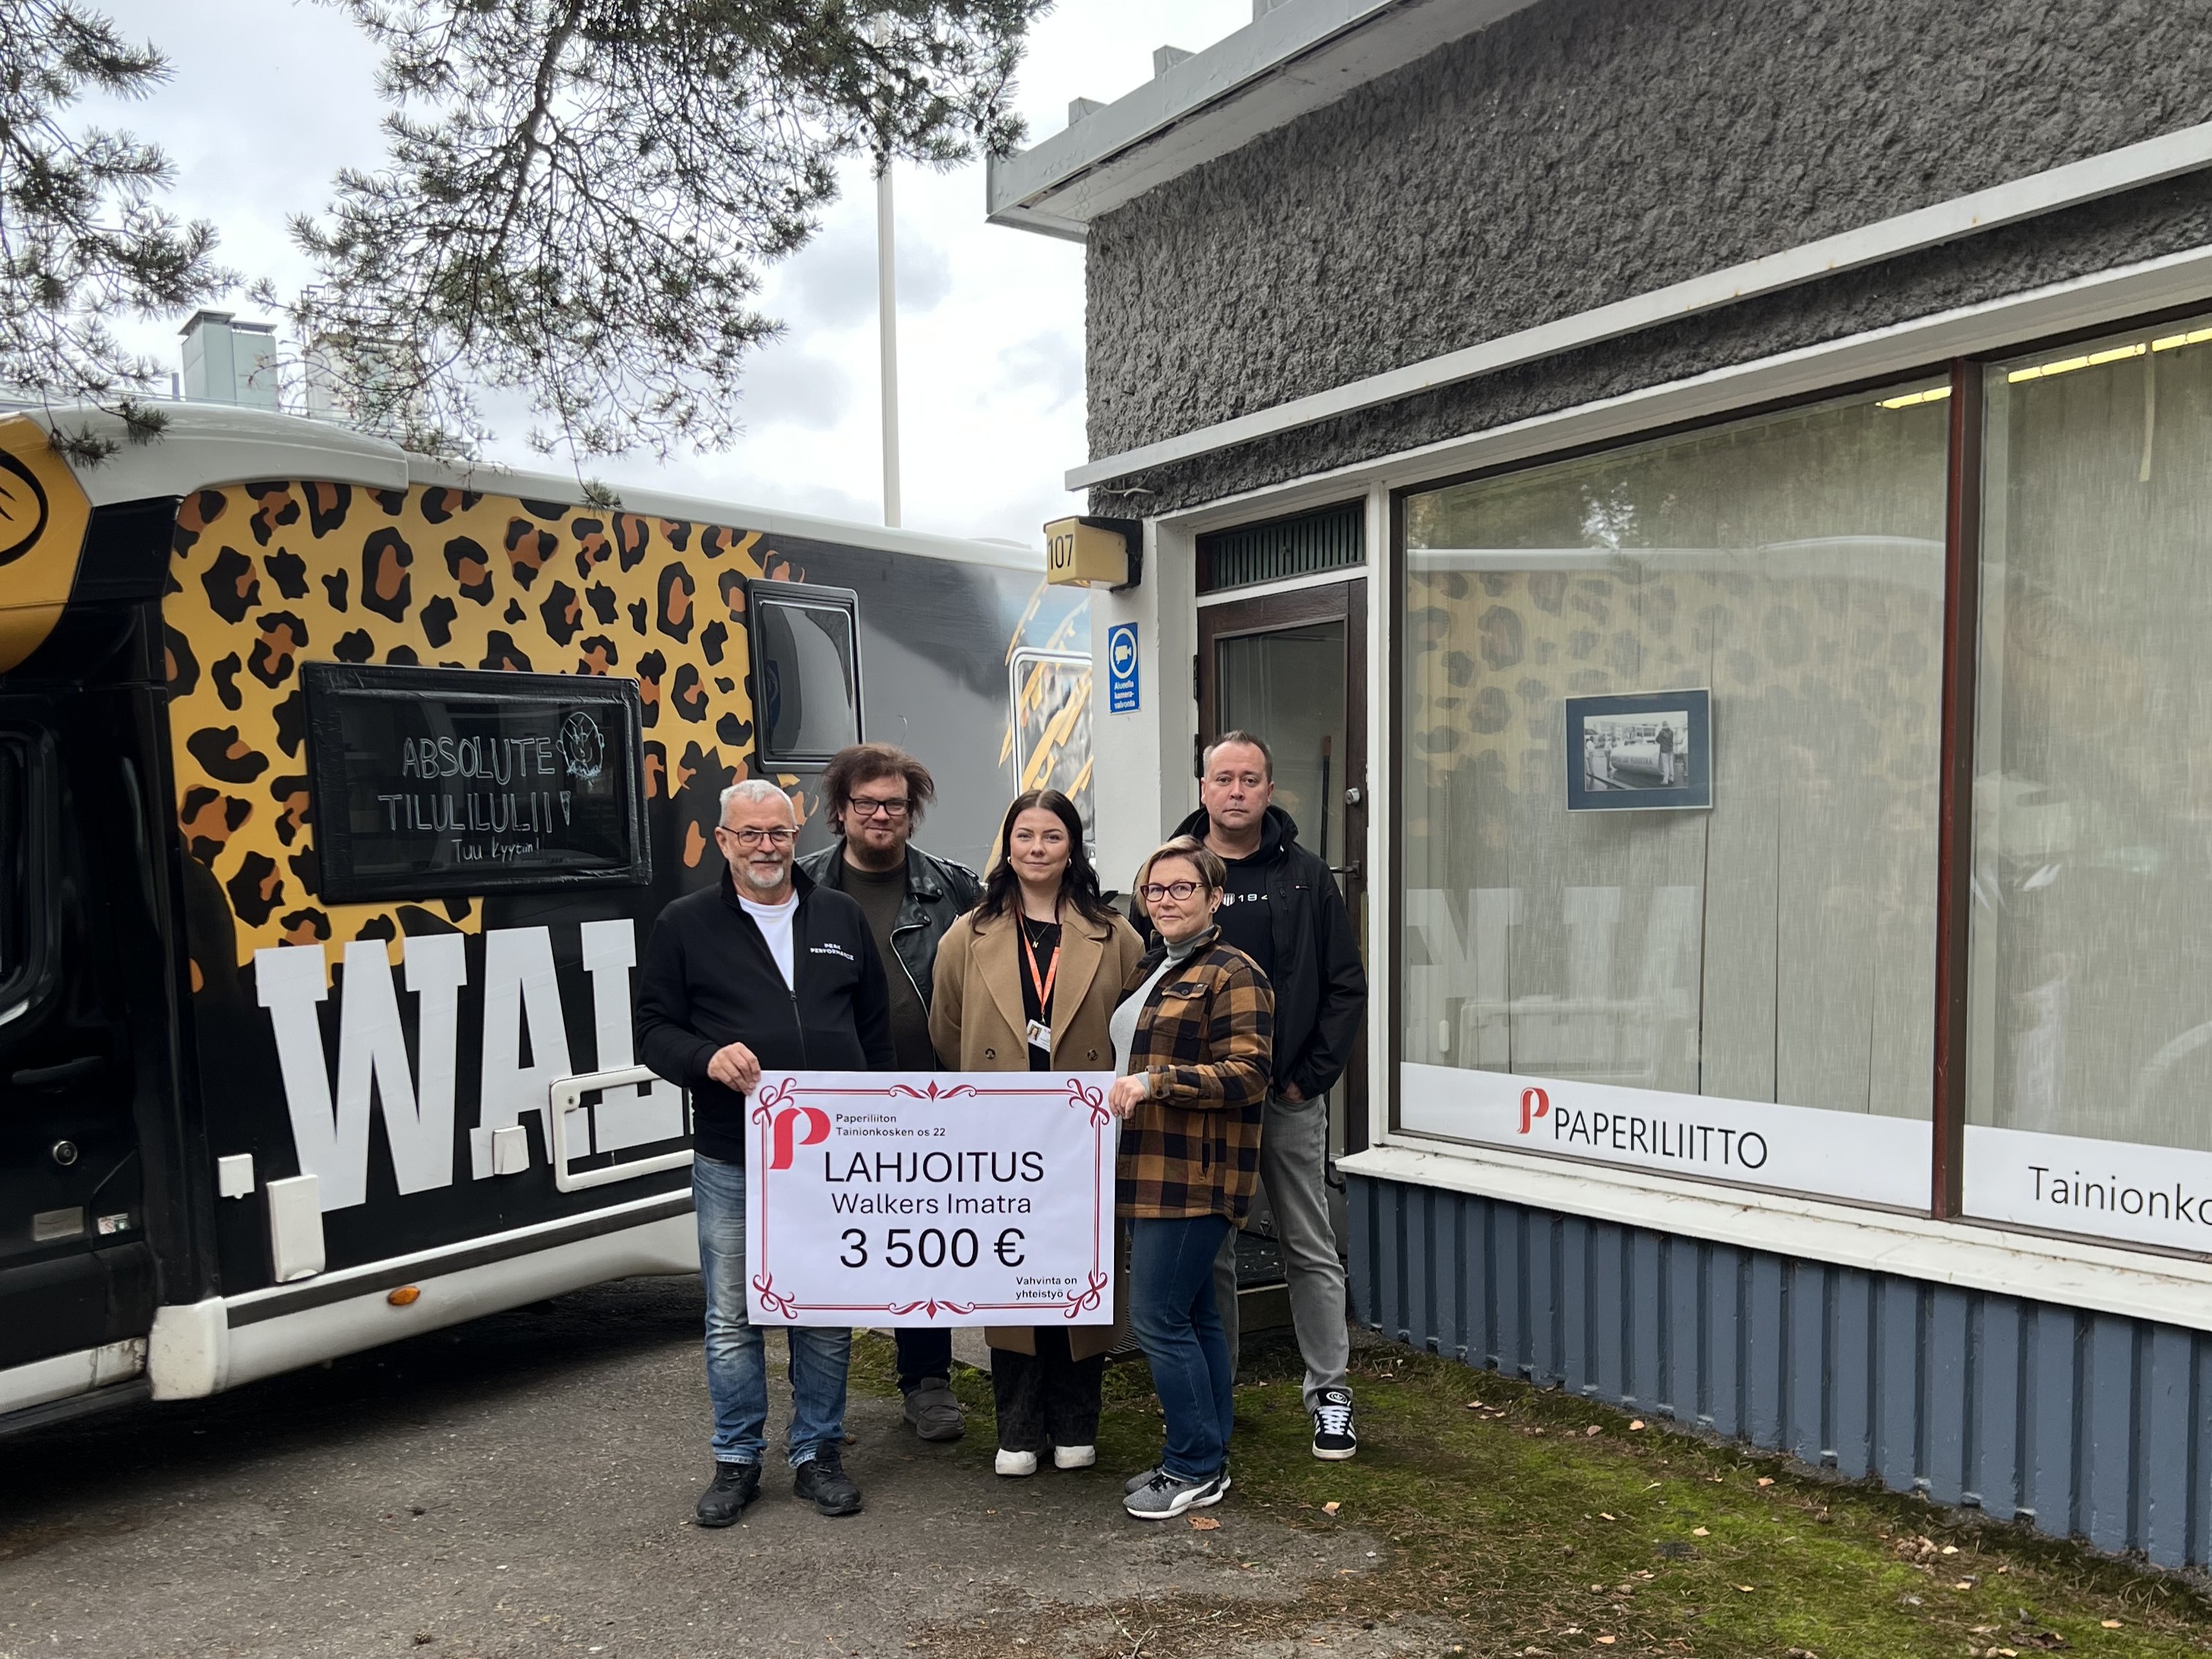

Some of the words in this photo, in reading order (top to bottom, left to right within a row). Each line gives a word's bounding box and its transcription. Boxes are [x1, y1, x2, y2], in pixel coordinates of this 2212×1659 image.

[1048, 534, 1074, 570] 107
[402, 736, 555, 785] ABSOLUTE
[451, 839, 483, 863] Tuu
[810, 947, 854, 960] PERFORMANCE
[254, 918, 694, 1213] WAL
[836, 1113, 897, 1124] Paperiliiton
[836, 1127, 914, 1137] Tainionkosken
[933, 1127, 946, 1137] 22
[1555, 1107, 1767, 1169] PAPERILIITTO
[825, 1151, 1044, 1183] LAHJOITUS
[832, 1192, 938, 1214] Walkers
[949, 1193, 1031, 1214] Imatra
[840, 1228, 868, 1268] 3
[885, 1227, 979, 1268] 500
[993, 1227, 1026, 1268] €
[1015, 1276, 1061, 1285] Vahvinta
[1015, 1289, 1064, 1301] yhteistyö
